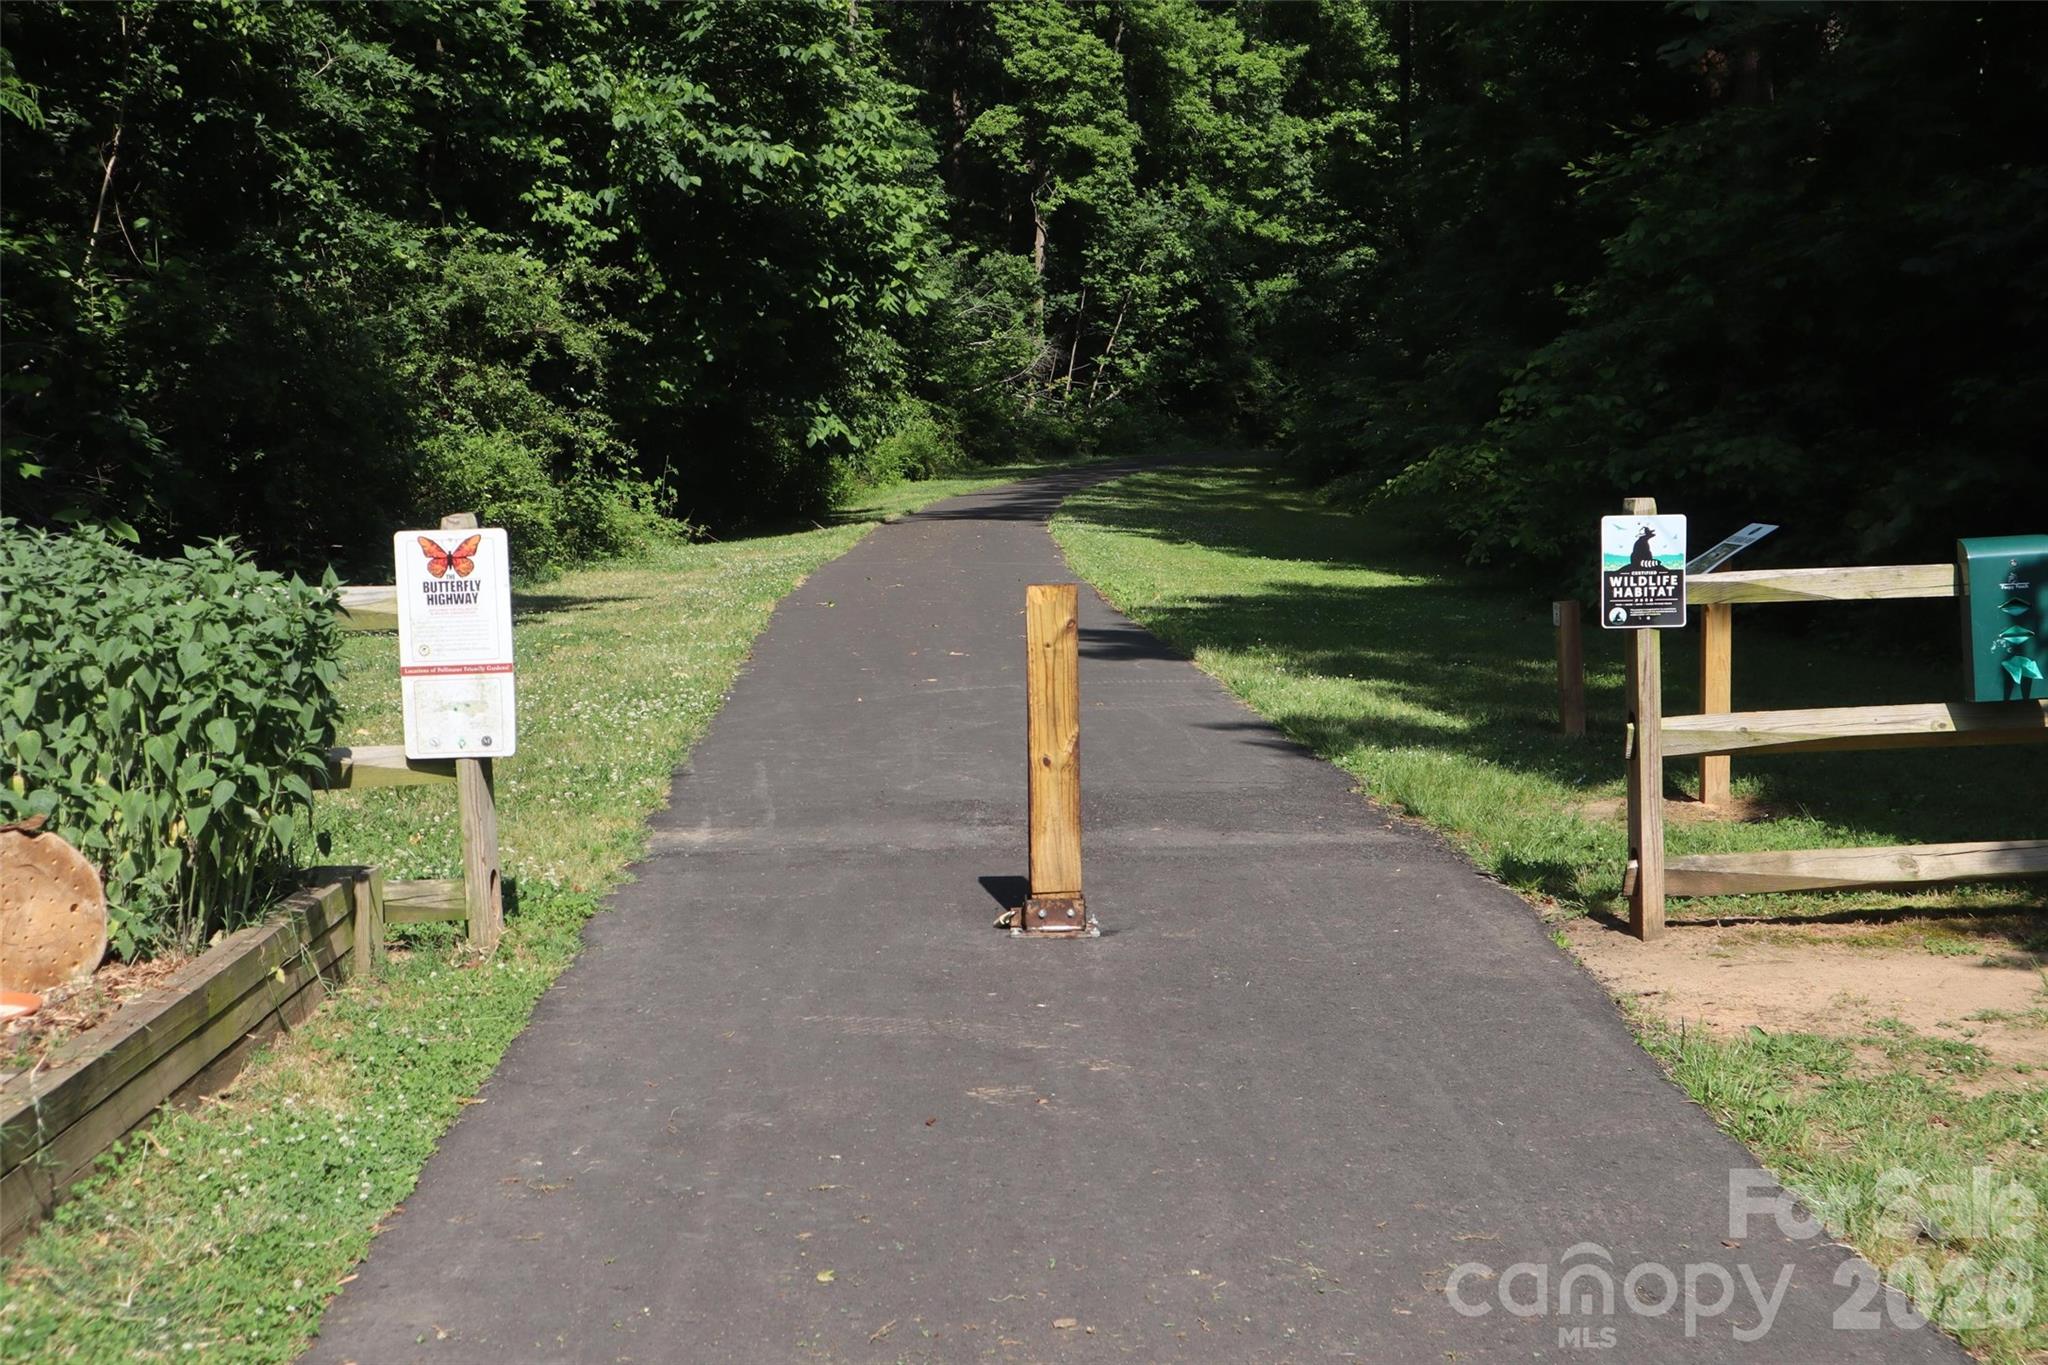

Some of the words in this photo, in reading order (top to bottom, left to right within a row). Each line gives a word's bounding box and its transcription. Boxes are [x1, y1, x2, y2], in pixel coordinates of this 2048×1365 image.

[423, 580, 481, 593] BUTTERFLY
[1610, 575, 1678, 587] WILDLIFE
[1613, 586, 1675, 598] HABITAT
[427, 593, 478, 605] HIGHWAY
